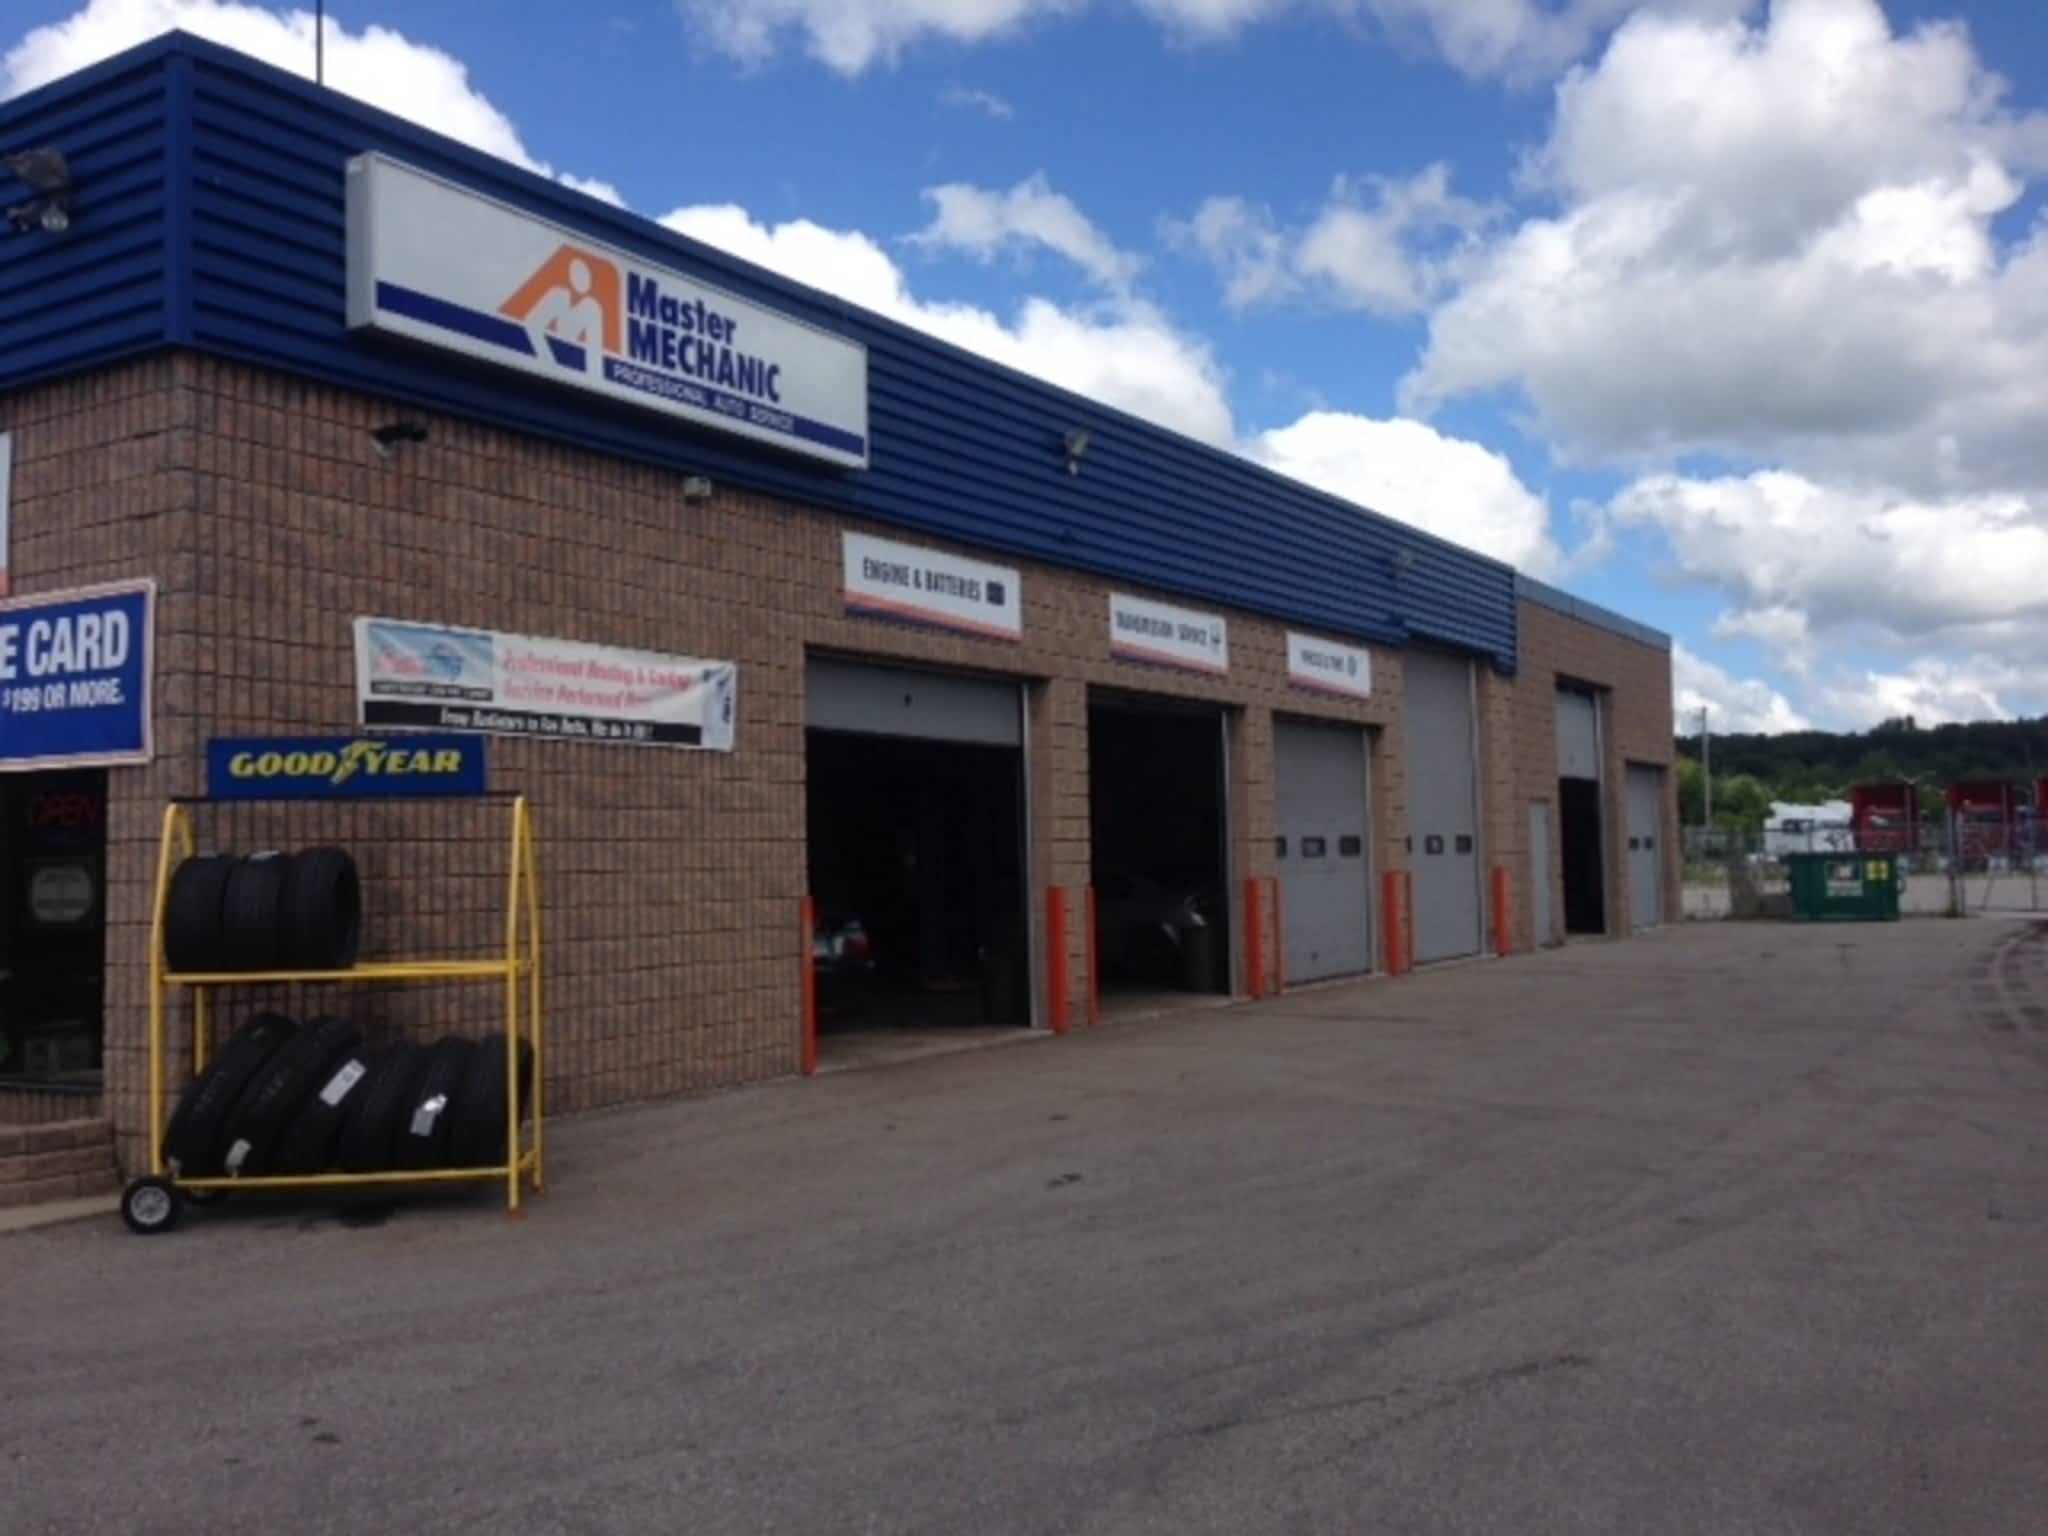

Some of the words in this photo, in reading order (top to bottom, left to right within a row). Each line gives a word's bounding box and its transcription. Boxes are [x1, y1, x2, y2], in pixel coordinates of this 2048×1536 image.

[628, 272, 737, 344] Master
[628, 316, 781, 403] MECHANIC
[863, 556, 910, 587] ENGINE
[914, 568, 922, 590] &
[925, 570, 981, 602] BATTERIES
[26, 609, 129, 677] CARD
[44, 682, 66, 710] OR
[69, 677, 125, 707] MORE.
[229, 741, 462, 780] GOODYEAR
